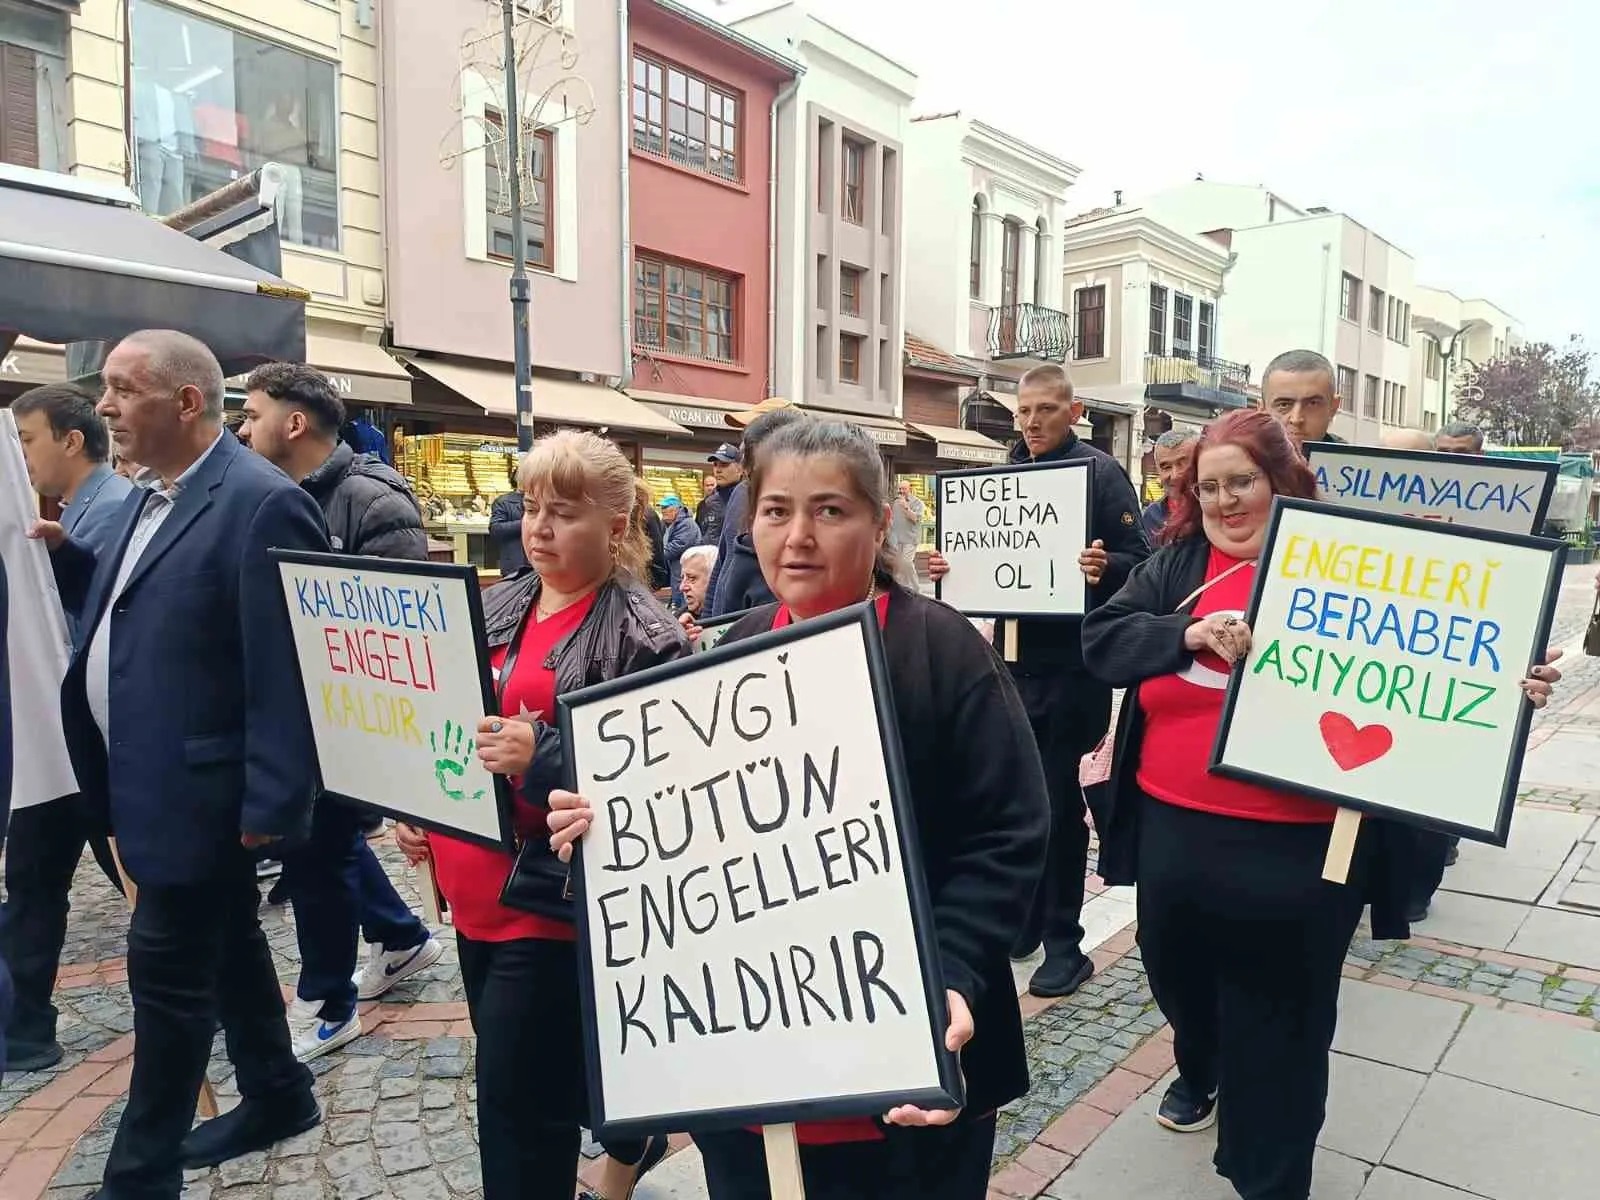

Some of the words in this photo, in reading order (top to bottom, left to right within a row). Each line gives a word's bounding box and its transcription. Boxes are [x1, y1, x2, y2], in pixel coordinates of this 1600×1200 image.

[705, 412, 727, 425] KUY
[944, 476, 1028, 504] ENGEL
[985, 502, 1059, 529] OLMA
[1314, 465, 1535, 513] AŞILMAYACAK
[944, 531, 1041, 553] FARKINDA
[1279, 534, 1503, 611] ENGELLERİ
[295, 575, 448, 633] KALBİNDEKİ
[995, 562, 1032, 590] OL
[323, 627, 437, 692] ENGELİ
[1286, 587, 1501, 673] BERABER
[320, 681, 424, 746] KALDIR
[1252, 639, 1498, 729] AŞIYORUZ
[592, 652, 798, 782] SEVGİ
[602, 745, 840, 872] BÜTÜN
[597, 799, 891, 968] ENGELLERİ
[614, 930, 907, 1055] KALDIRIR
